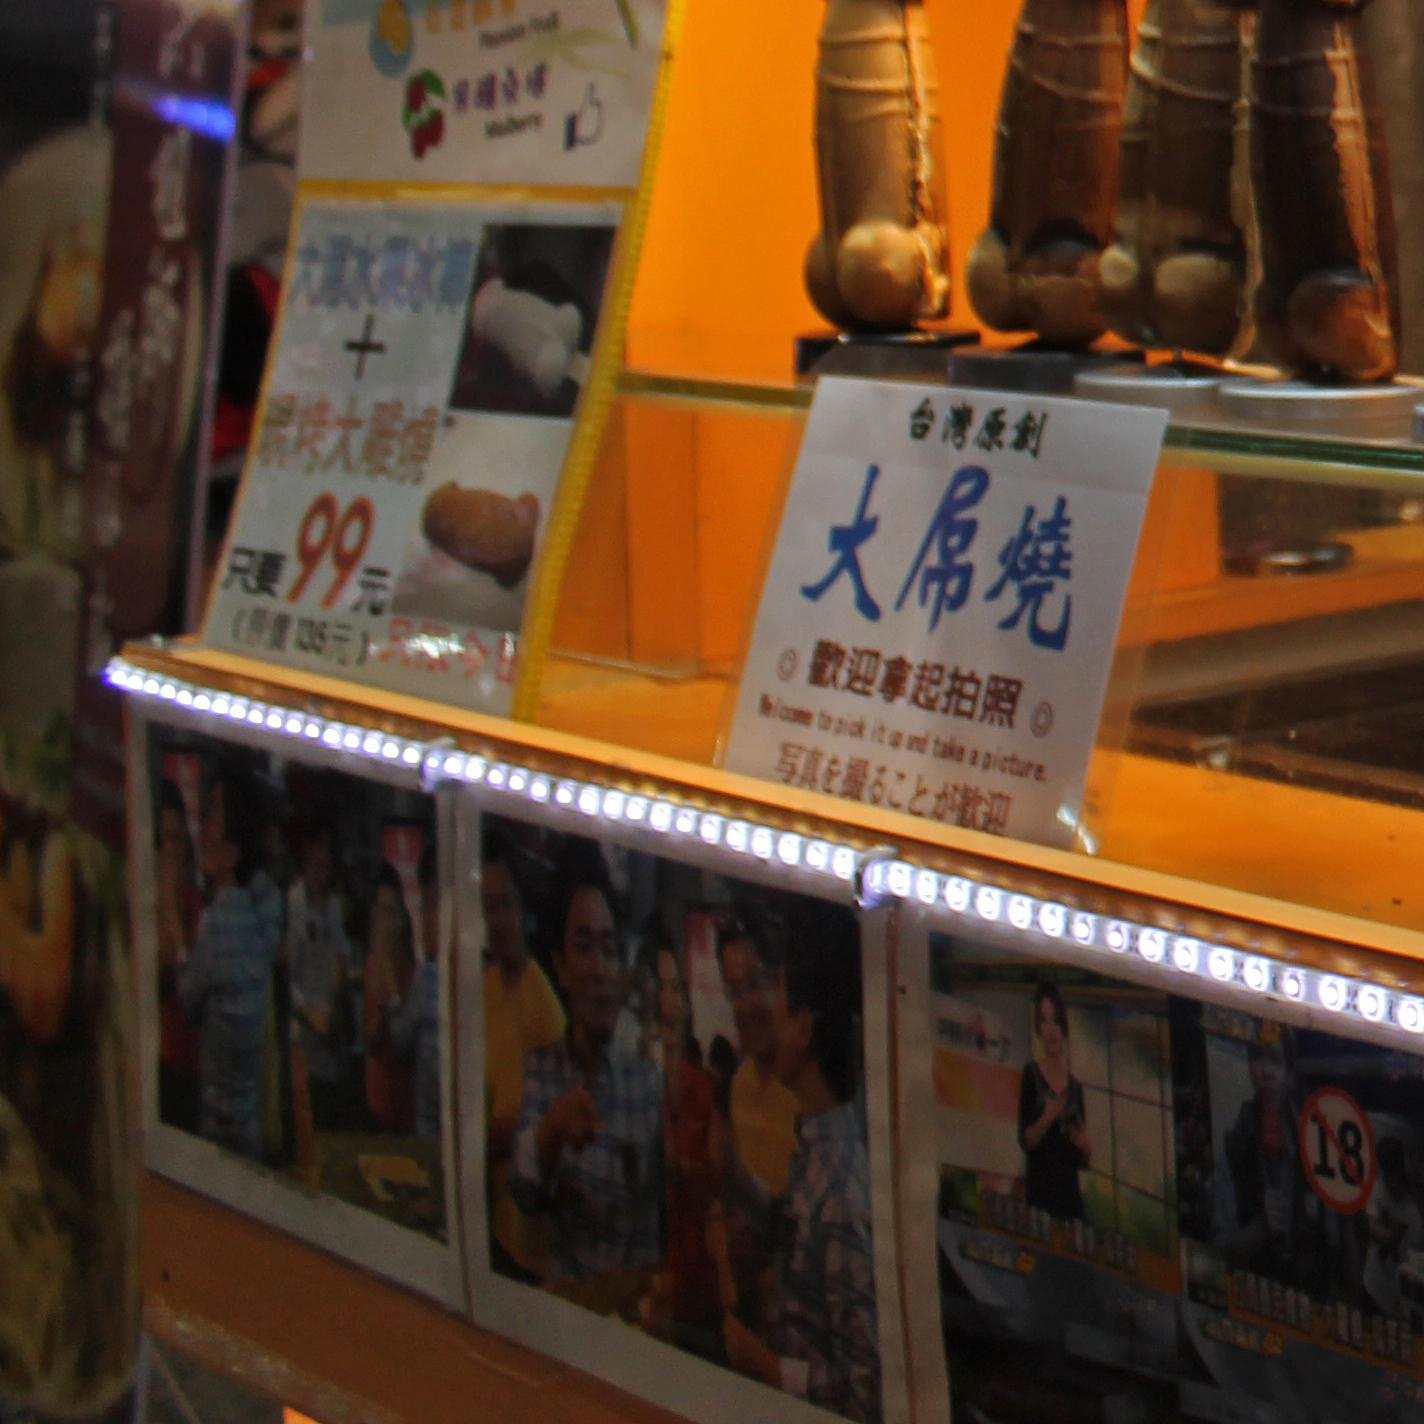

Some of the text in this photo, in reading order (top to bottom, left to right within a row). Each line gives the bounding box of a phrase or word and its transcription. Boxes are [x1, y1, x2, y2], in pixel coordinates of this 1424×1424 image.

[908, 396, 1050, 460] 台灣原創
[799, 462, 1076, 653] 大屌燒
[808, 638, 1024, 728] 歡迎拿起拍照
[818, 711, 833, 732] to
[833, 714, 865, 740] pick
[906, 730, 930, 756] and
[932, 736, 965, 763] take
[1311, 1089, 1368, 1188] 18
